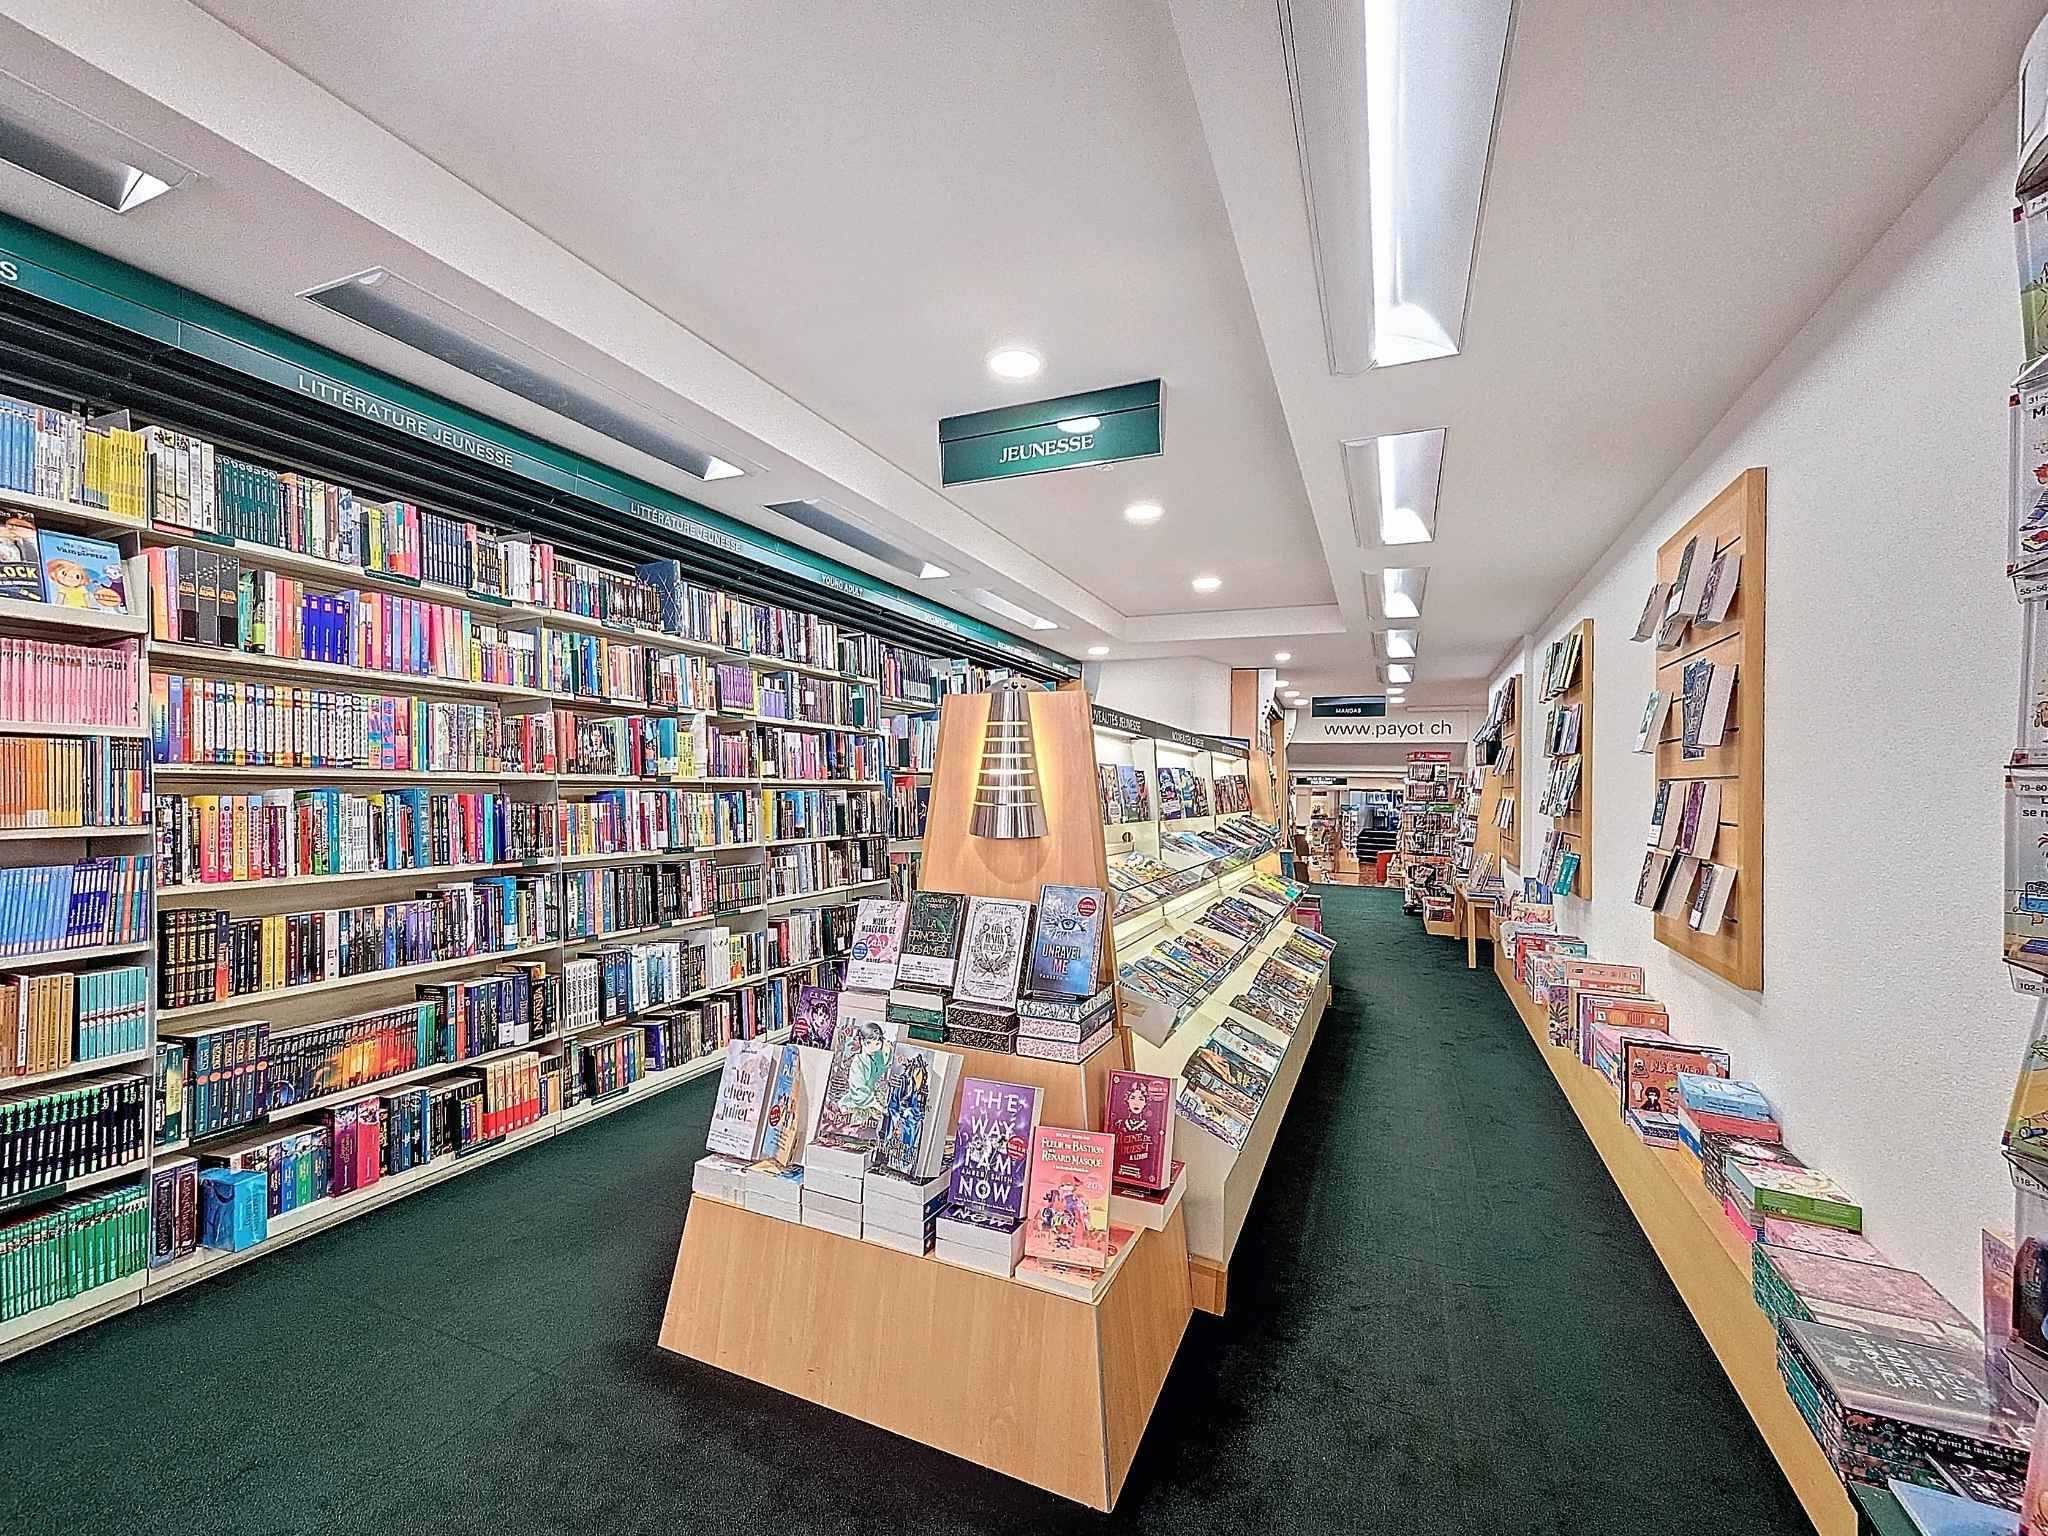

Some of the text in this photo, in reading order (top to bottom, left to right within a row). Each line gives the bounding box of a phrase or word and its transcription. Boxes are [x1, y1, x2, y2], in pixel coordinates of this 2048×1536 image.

[298, 374, 513, 468] LITTÉRATURE JEUNESSE
[999, 434, 1094, 463] JEUNESSE
[631, 502, 741, 551] LITTÉRATURE JEUNESSE
[820, 574, 864, 598] YOUNG ADULT
[1324, 720, 1452, 738] www.payot.ch
[927, 919, 937, 929] LA
[908, 930, 953, 944] PRINCESSE
[907, 944, 922, 954] DES
[1042, 944, 1081, 960] UNRAVEL
[1053, 958, 1069, 975] ME
[723, 1084, 755, 1103] chère
[973, 1088, 1019, 1113] THE
[971, 1115, 1016, 1138] WAY
[1041, 1137, 1064, 1150] FLEUR
[1072, 1141, 1104, 1154] BASTION
[978, 1152, 1012, 1176] AM
[1041, 1150, 1071, 1162] RENARD
[991, 1173, 1013, 1184] SMITH
[958, 1176, 1011, 1204] NOW
